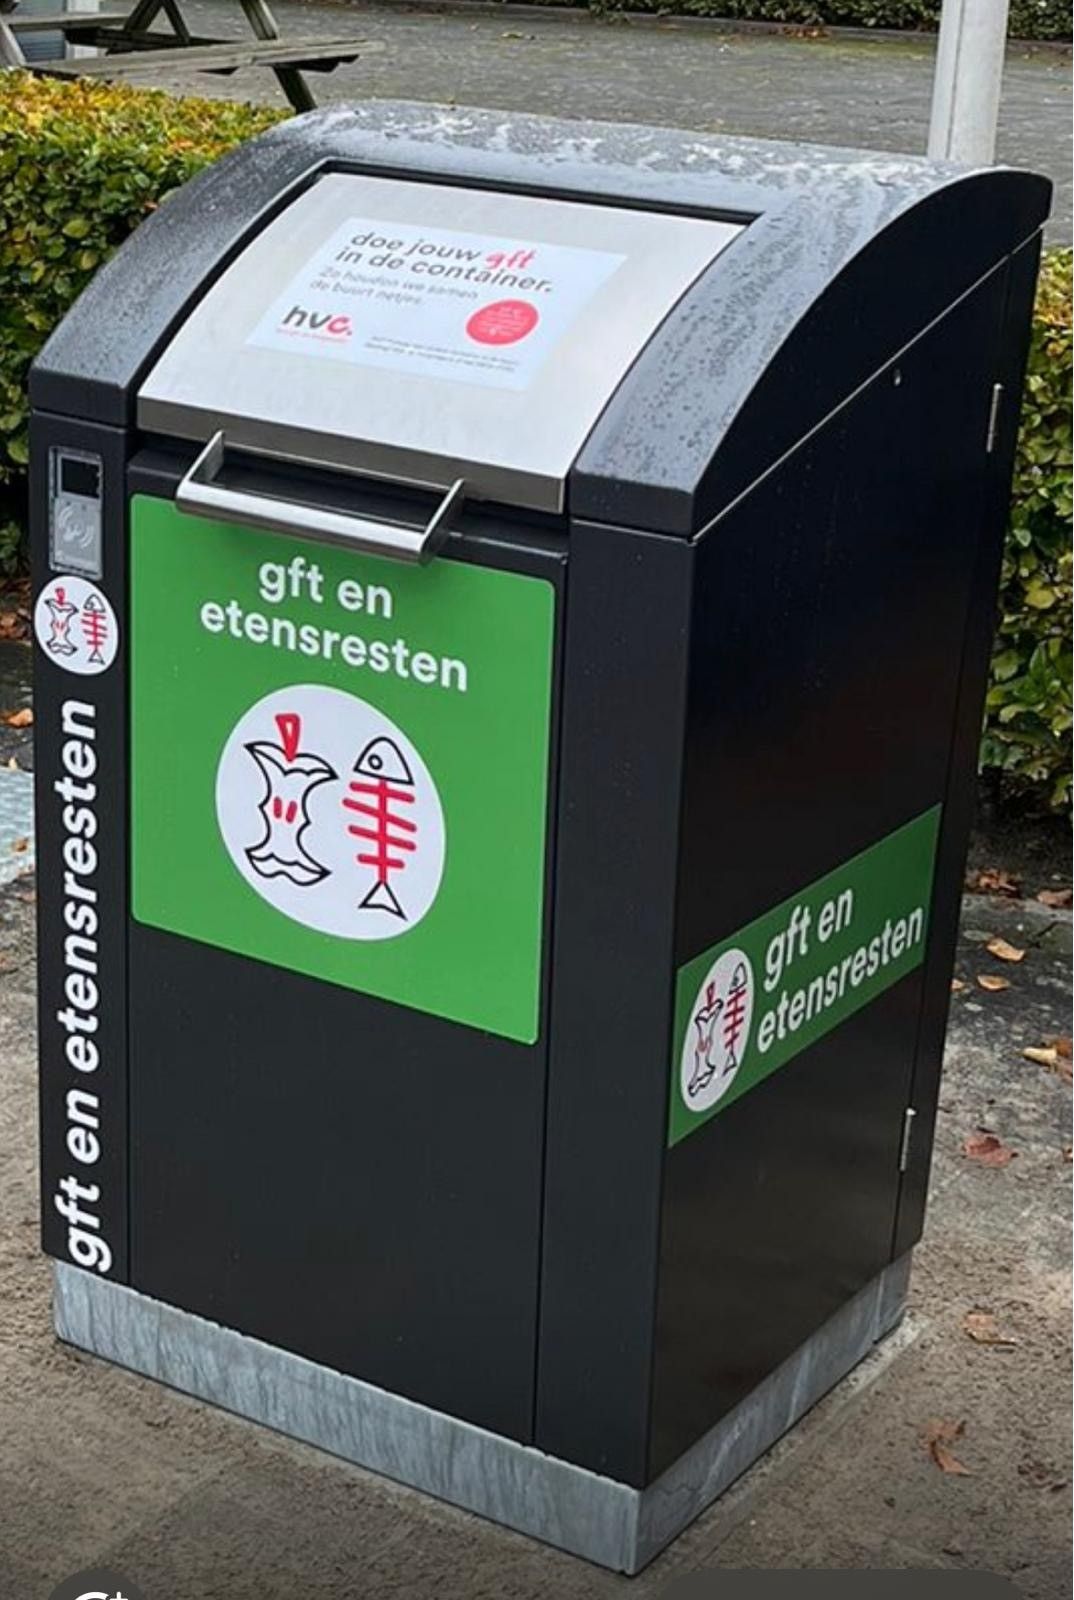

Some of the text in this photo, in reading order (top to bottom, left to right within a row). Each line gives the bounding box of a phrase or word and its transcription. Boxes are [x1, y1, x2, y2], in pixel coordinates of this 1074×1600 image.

[335, 247, 552, 292] in de container.
[350, 231, 536, 270] doe jouw gft
[258, 556, 393, 619] gft en
[200, 600, 468, 693] etensresten
[55, 700, 113, 1273] gft en etensresten
[757, 906, 924, 1053] etensresten
[764, 888, 853, 993] gft en
